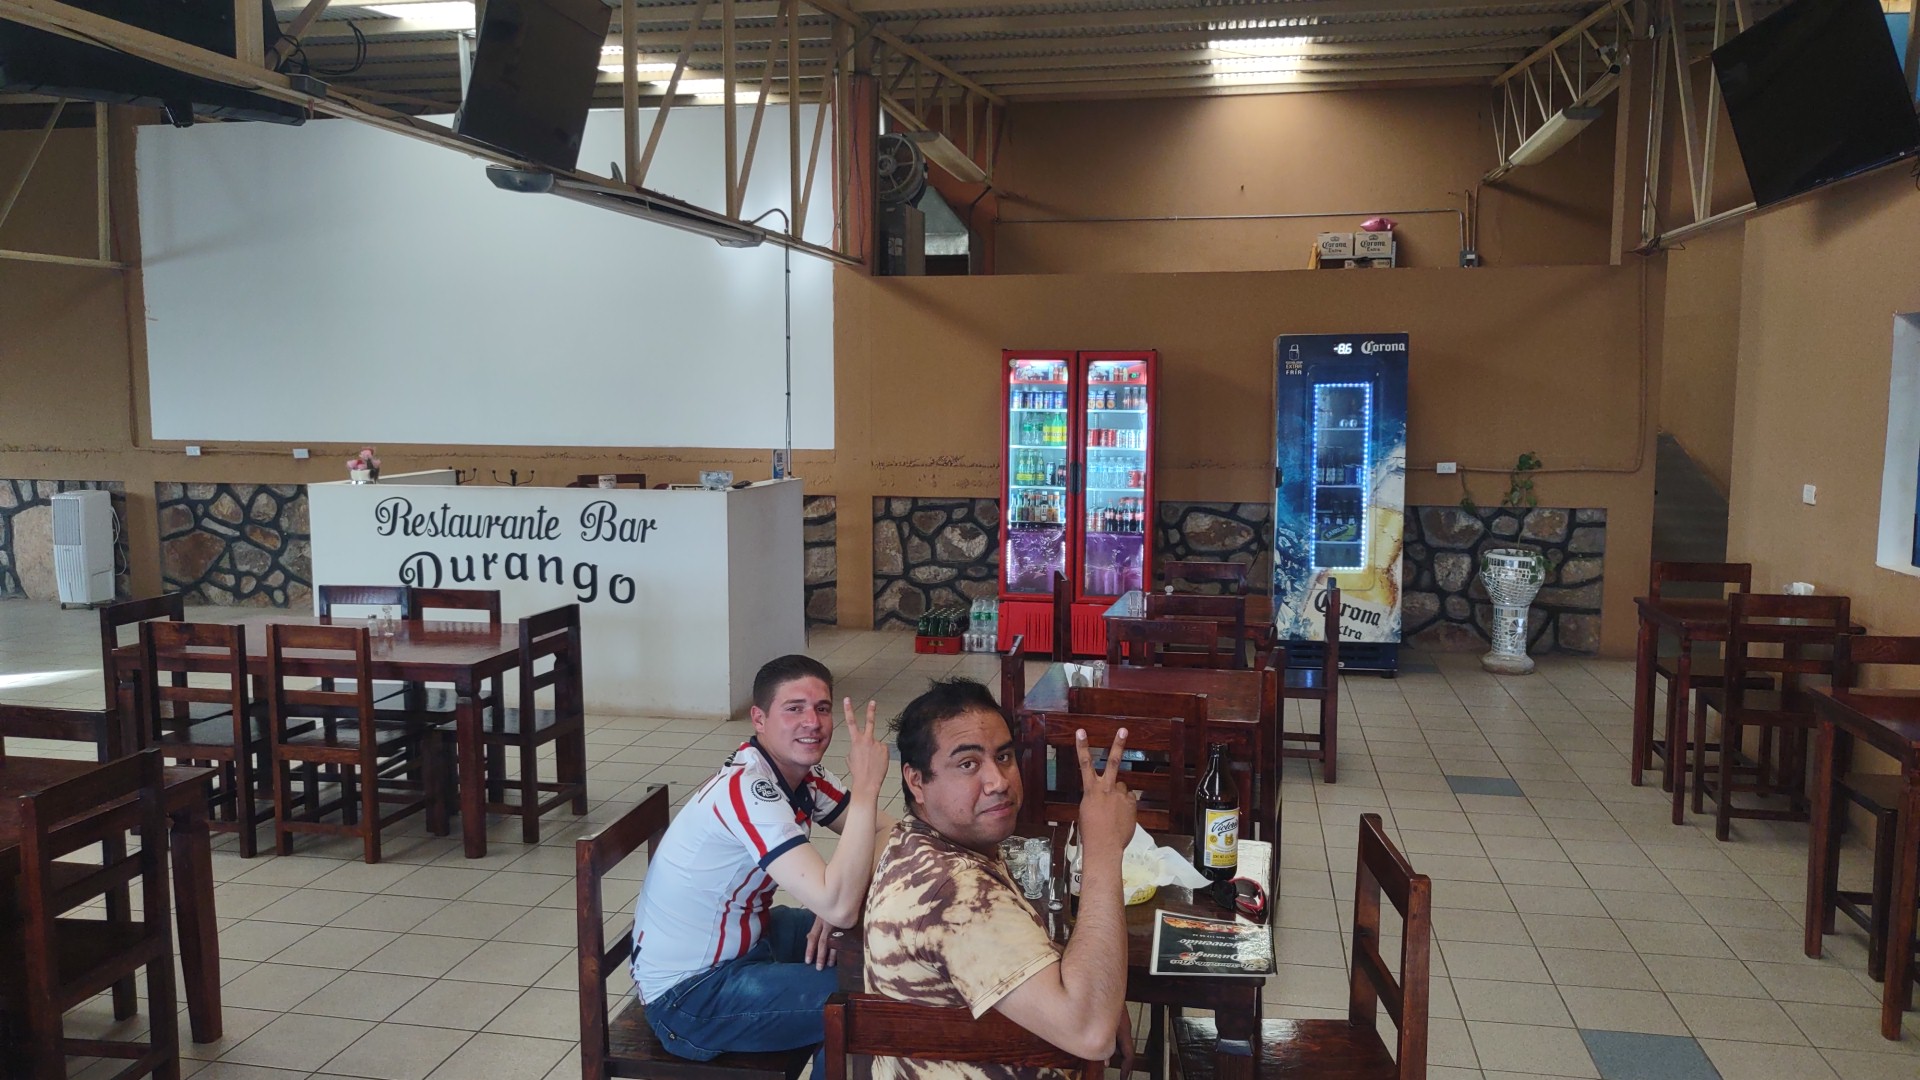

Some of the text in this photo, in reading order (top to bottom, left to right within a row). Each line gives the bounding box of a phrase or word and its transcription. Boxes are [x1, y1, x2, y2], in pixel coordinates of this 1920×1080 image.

[1322, 241, 1347, 249] Corona
[1360, 240, 1386, 248] Corona
[1360, 340, 1406, 355] Corona
[375, 497, 658, 543] Restaurante Bar
[399, 551, 637, 604] Durango
[1314, 589, 1381, 626] Crona
